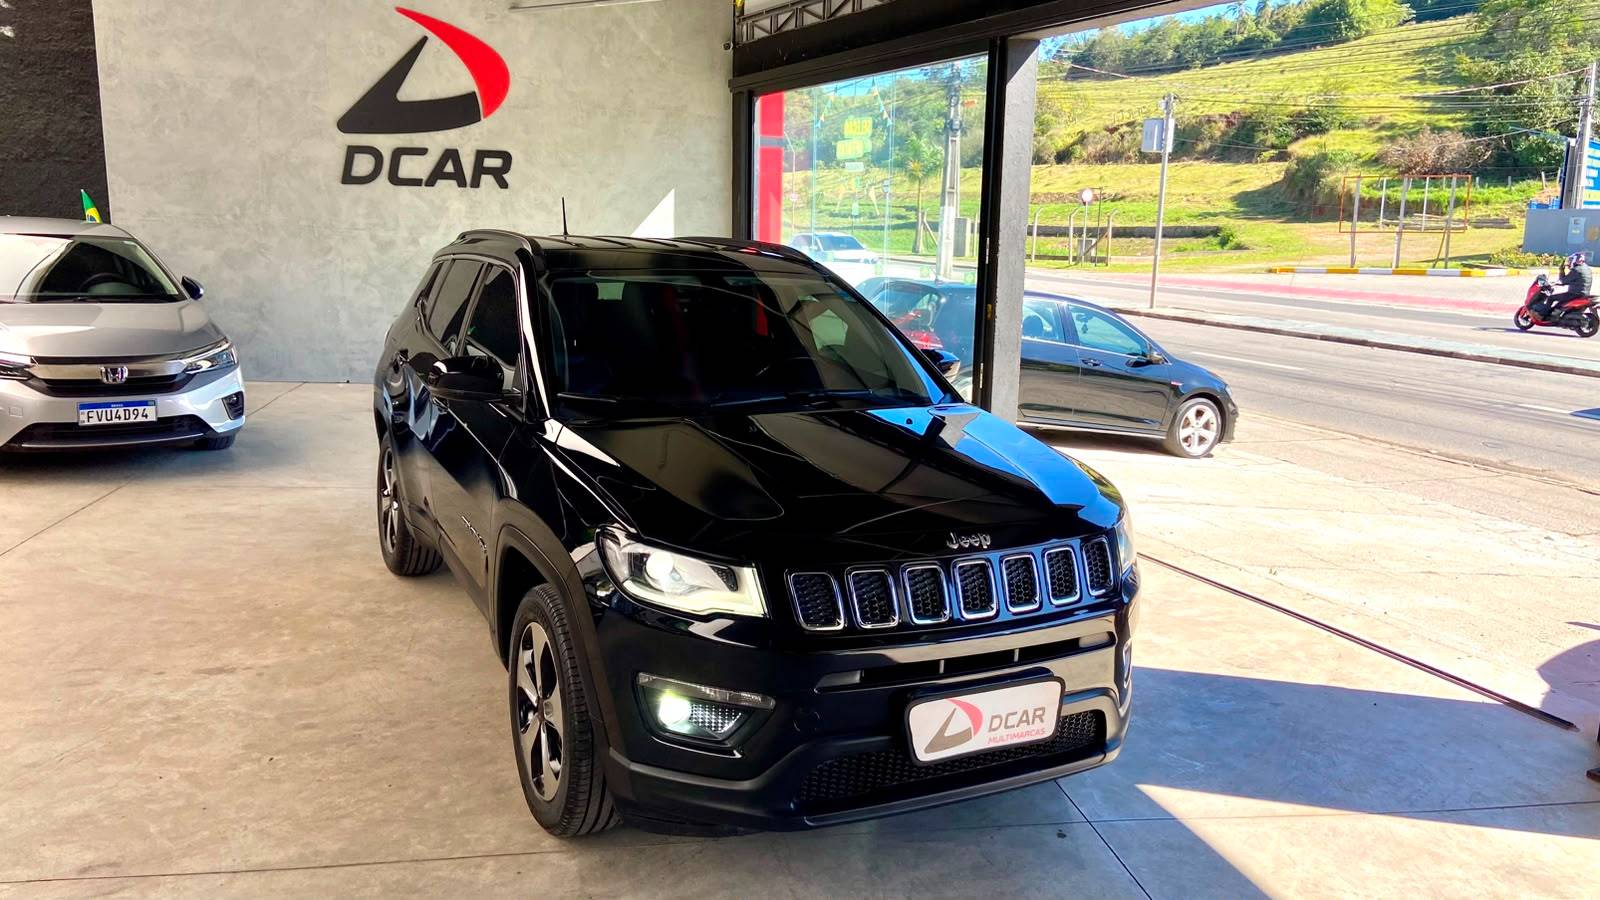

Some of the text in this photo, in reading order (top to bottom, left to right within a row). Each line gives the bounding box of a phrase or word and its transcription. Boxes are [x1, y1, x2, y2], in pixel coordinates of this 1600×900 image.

[341, 145, 513, 189] DCAR
[86, 408, 149, 423] FVU4D94
[946, 531, 991, 549] Jeep
[988, 706, 1046, 733] DCAR
[987, 727, 1046, 745] MULTIMARCAS
